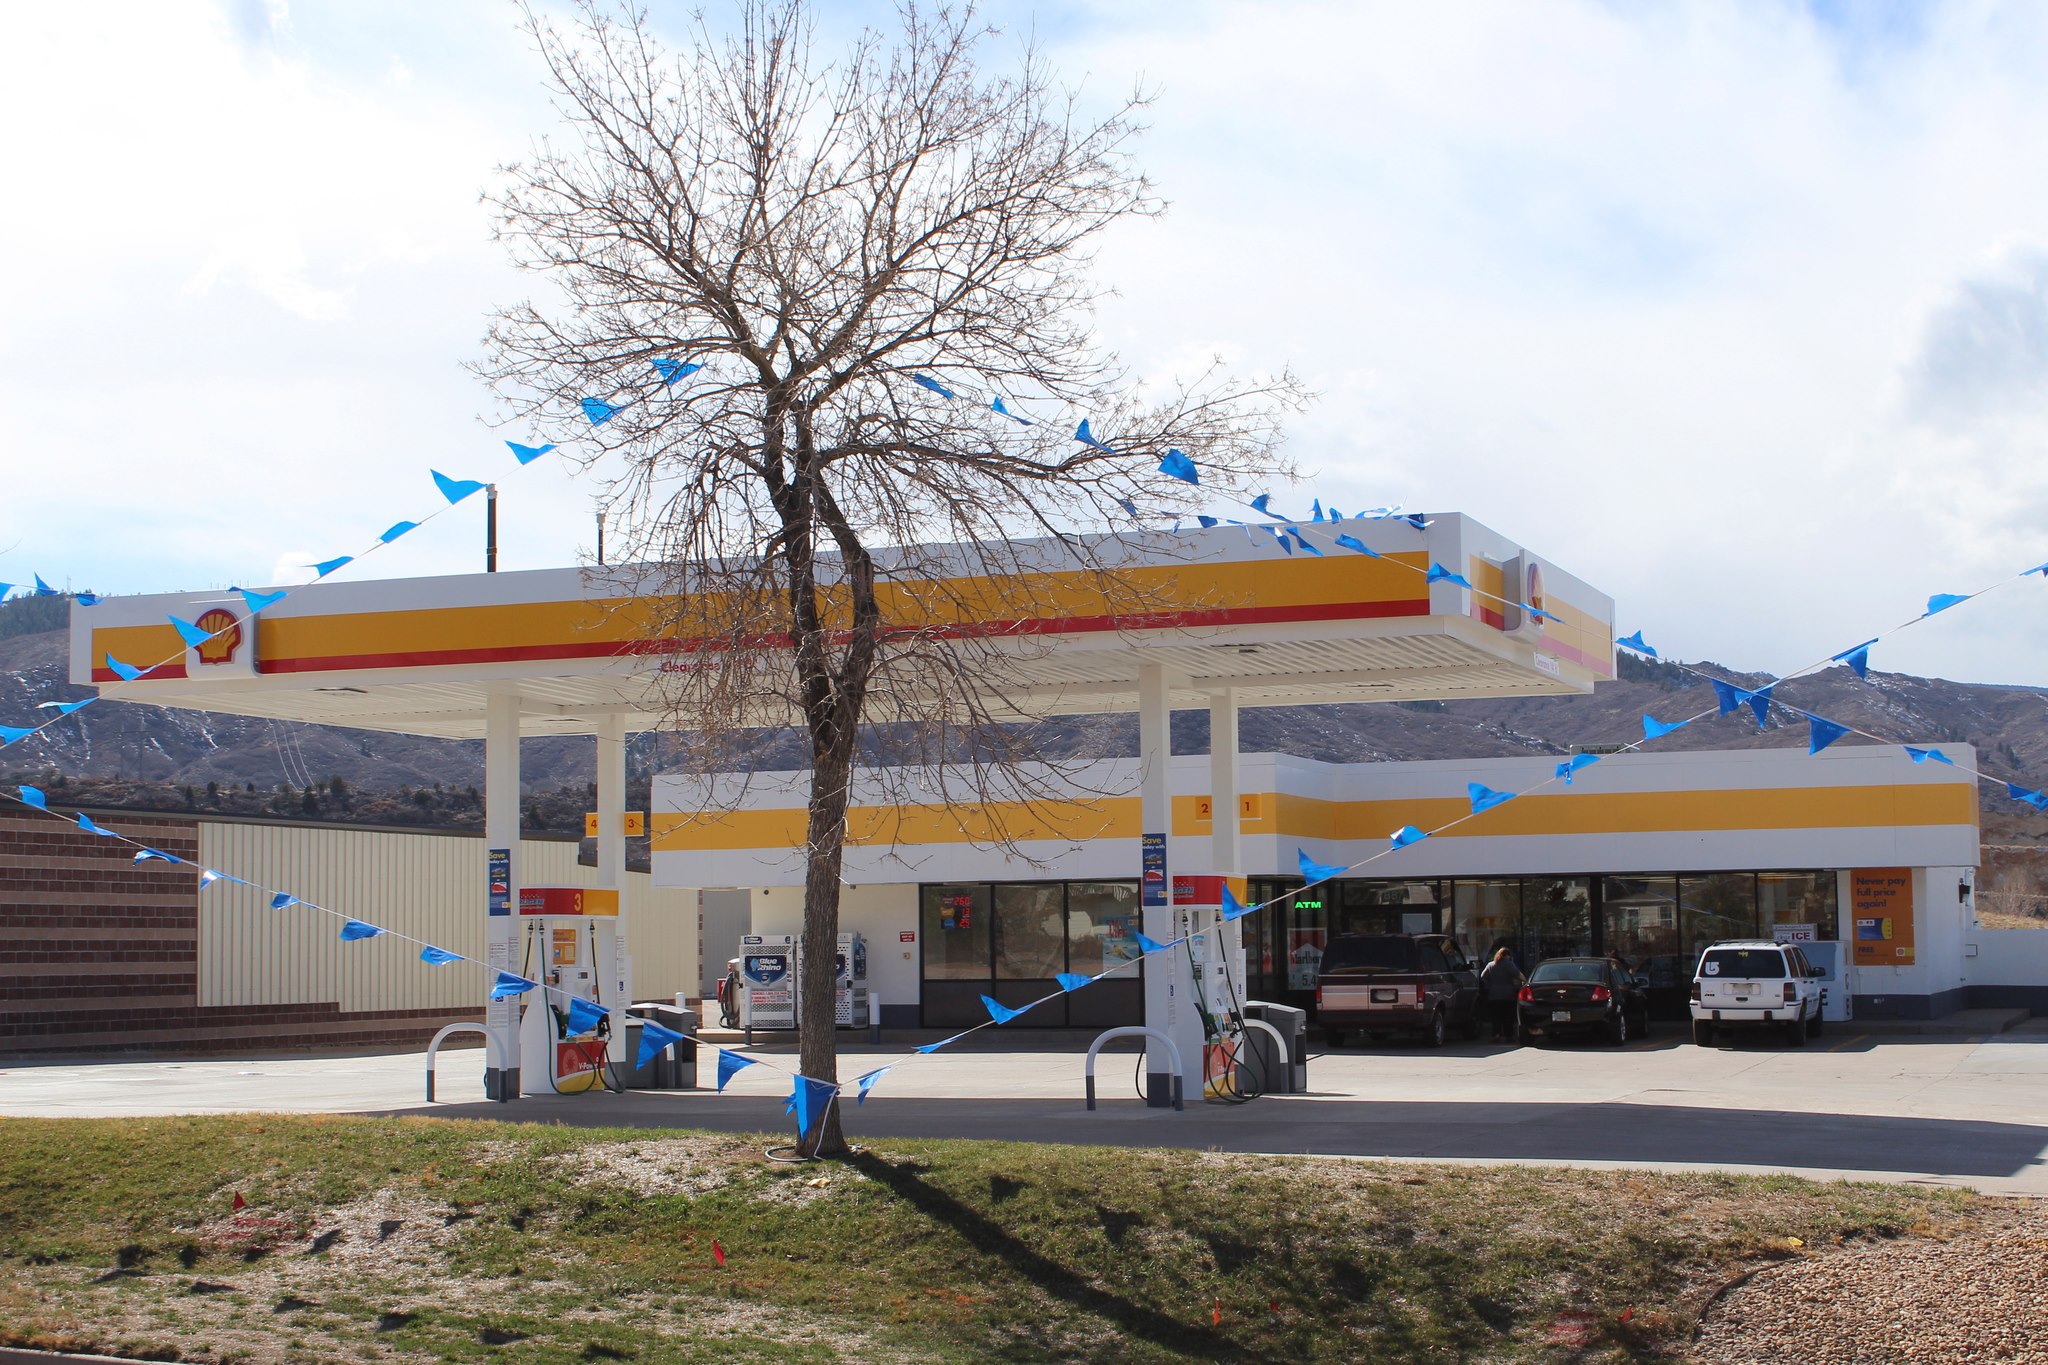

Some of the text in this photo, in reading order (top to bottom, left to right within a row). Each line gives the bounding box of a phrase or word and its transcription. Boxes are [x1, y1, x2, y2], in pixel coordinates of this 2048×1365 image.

[1201, 803, 1209, 813] 2
[1245, 801, 1250, 811] 1
[591, 819, 597, 828] 4
[628, 819, 635, 828] 3
[1856, 877, 1905, 886] Never pay
[1857, 888, 1896, 898] full price
[574, 893, 581, 911] 3
[1295, 901, 1321, 909] ATM
[1857, 900, 1887, 909] again!
[1791, 932, 1810, 940] ICE
[759, 957, 777, 965] Blue
[1291, 951, 1321, 964] Marlbor
[1302, 974, 1316, 986] 5.4
